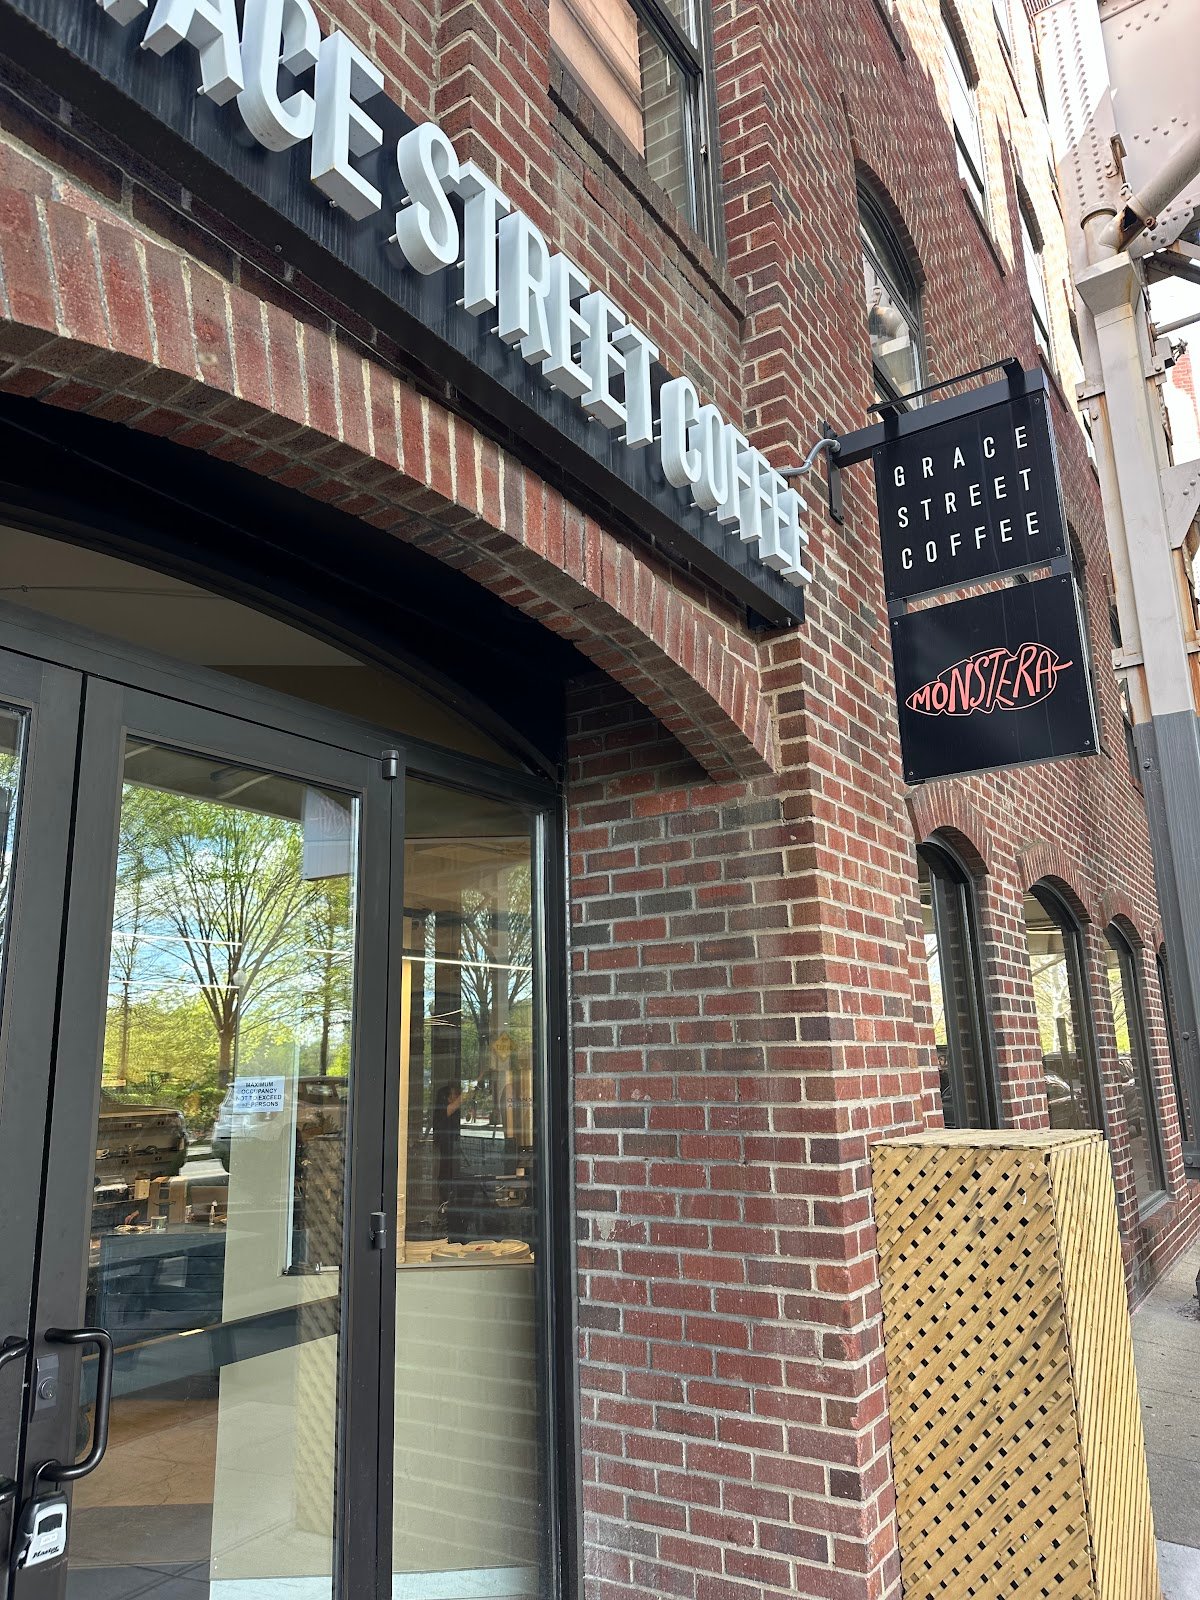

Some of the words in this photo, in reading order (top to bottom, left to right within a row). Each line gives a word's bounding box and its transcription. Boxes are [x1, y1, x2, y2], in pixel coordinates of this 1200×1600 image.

[396, 122, 660, 451] STREET
[660, 376, 812, 588] COFFEE
[894, 426, 1028, 487] GRACE
[897, 468, 1032, 528] STREET
[901, 511, 1040, 570] COFFEE
[912, 645, 1071, 713] MONSTERA
